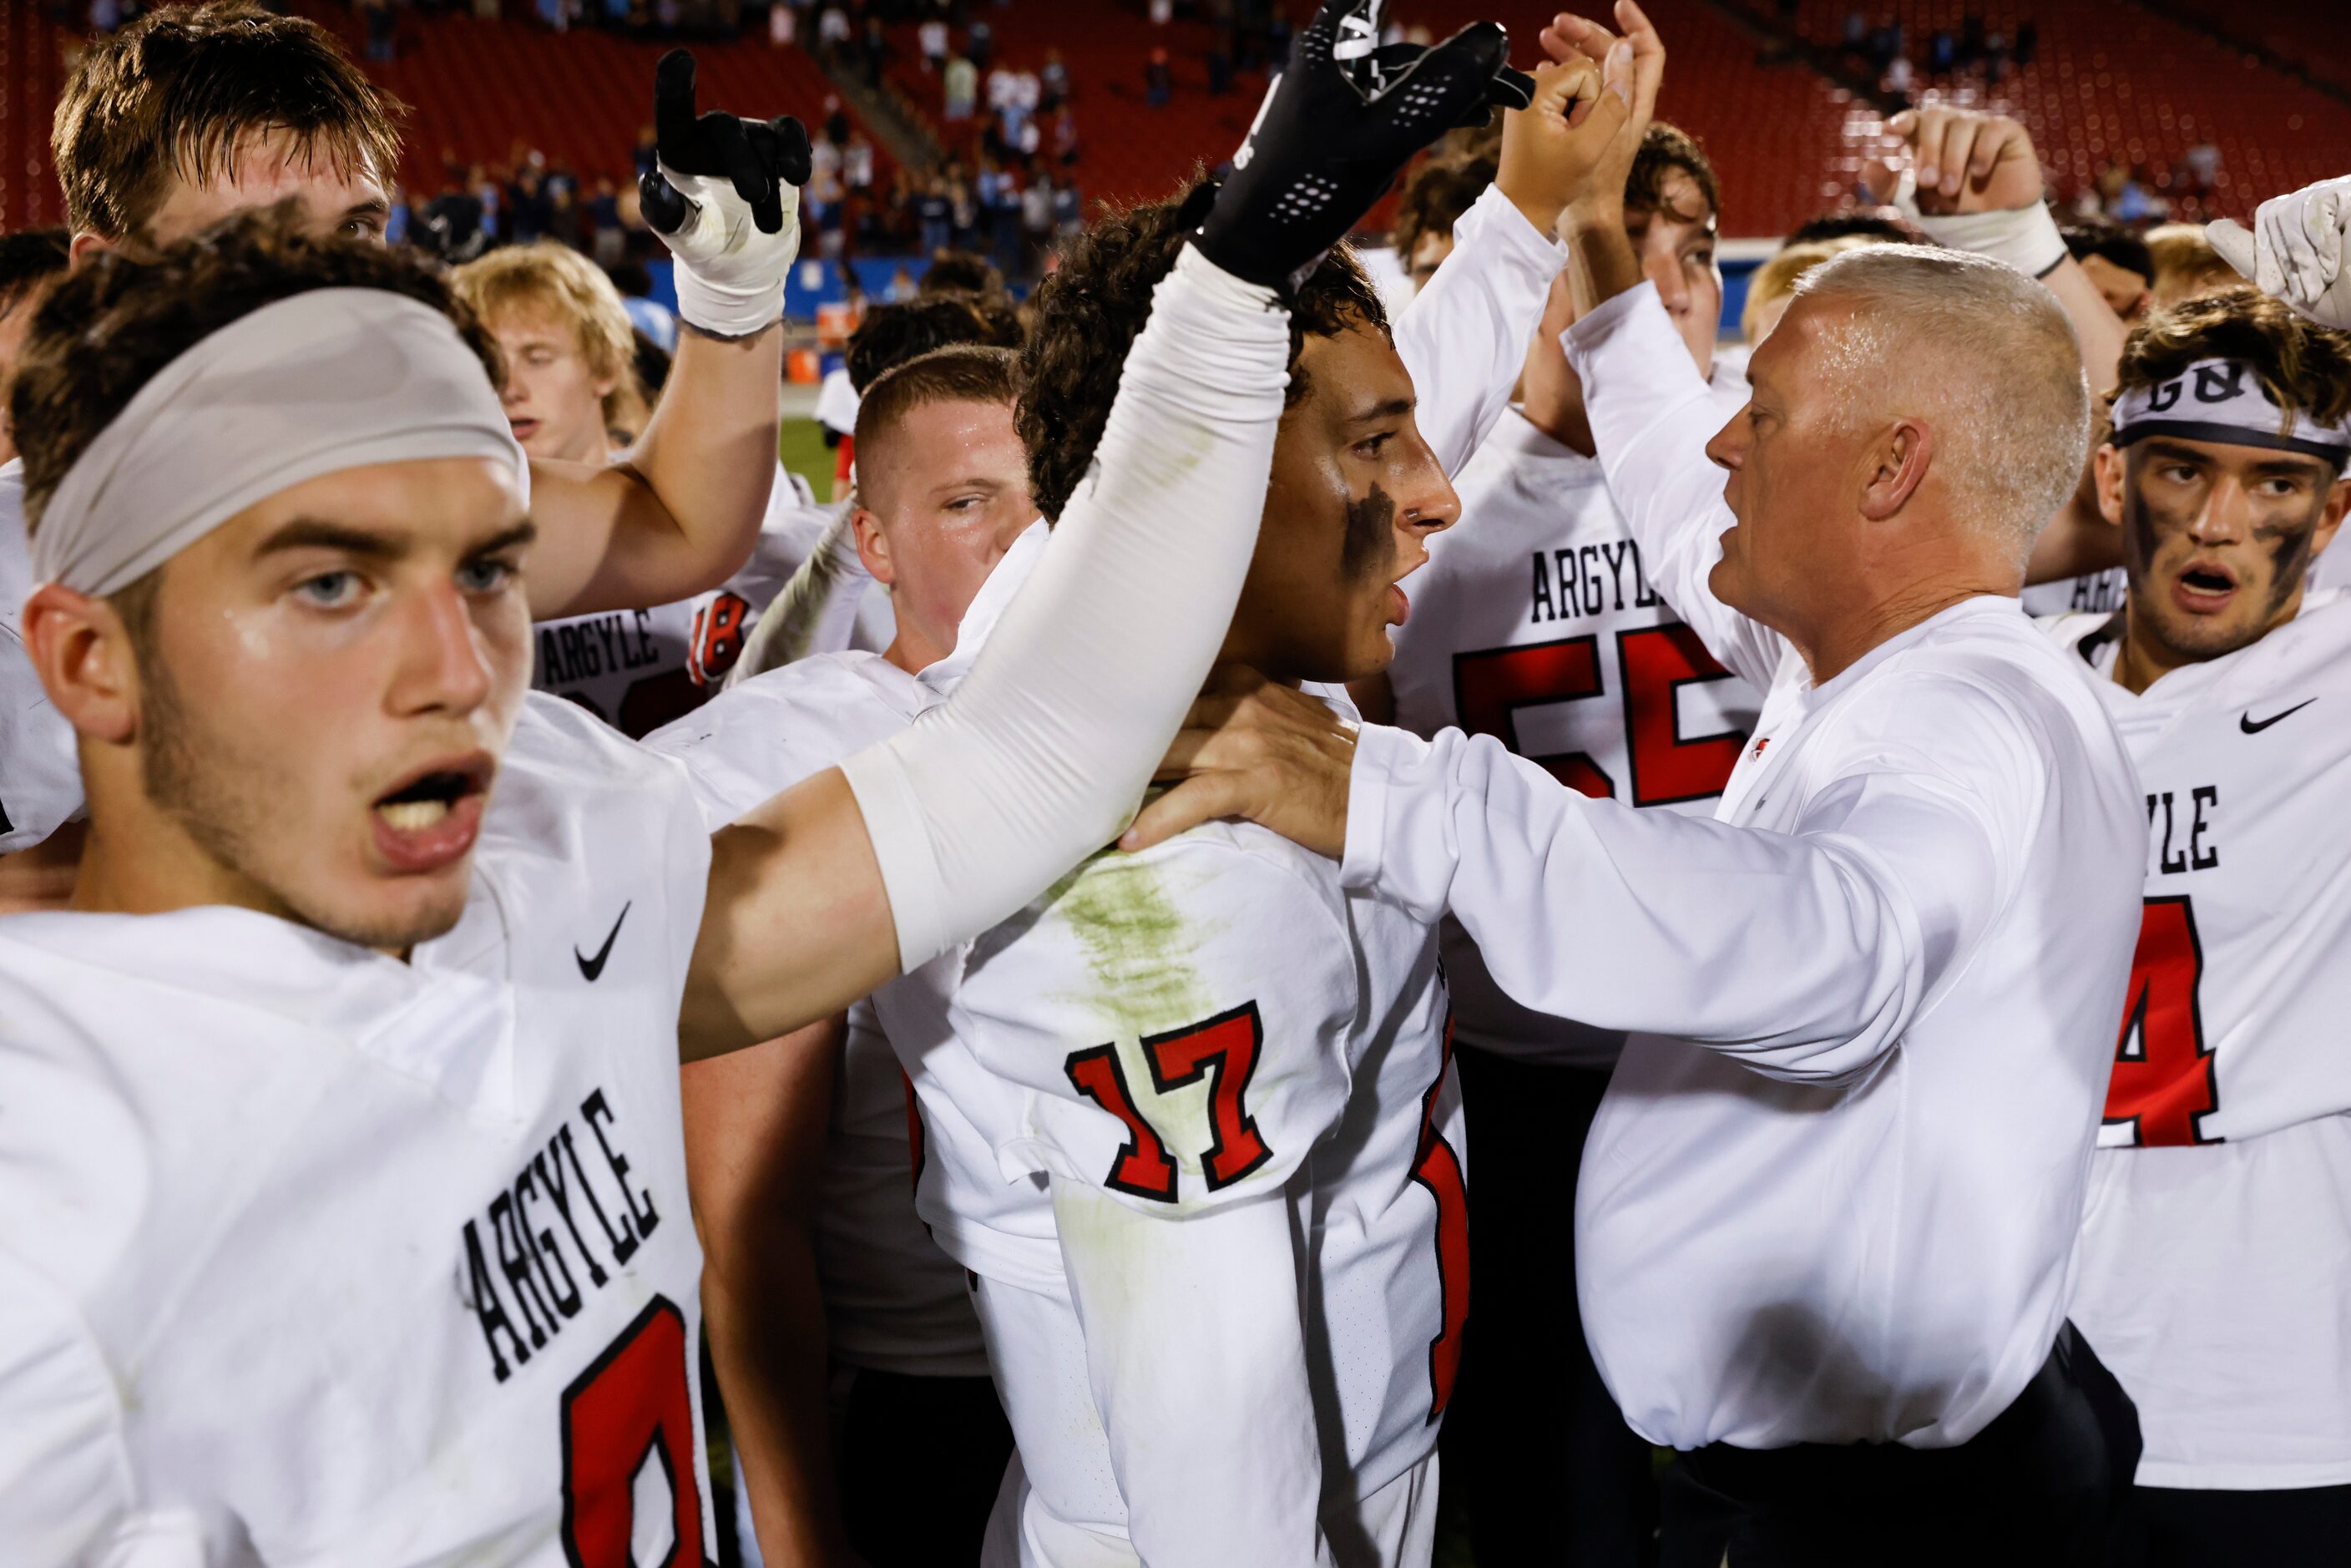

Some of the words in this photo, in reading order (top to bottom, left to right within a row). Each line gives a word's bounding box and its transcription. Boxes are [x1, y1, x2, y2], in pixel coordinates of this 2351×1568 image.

[540, 606, 660, 685] ARGYLE
[1531, 539, 1667, 624] ARGYL
[1064, 999, 1275, 1204] 17
[462, 1087, 660, 1384] ARGYLE
